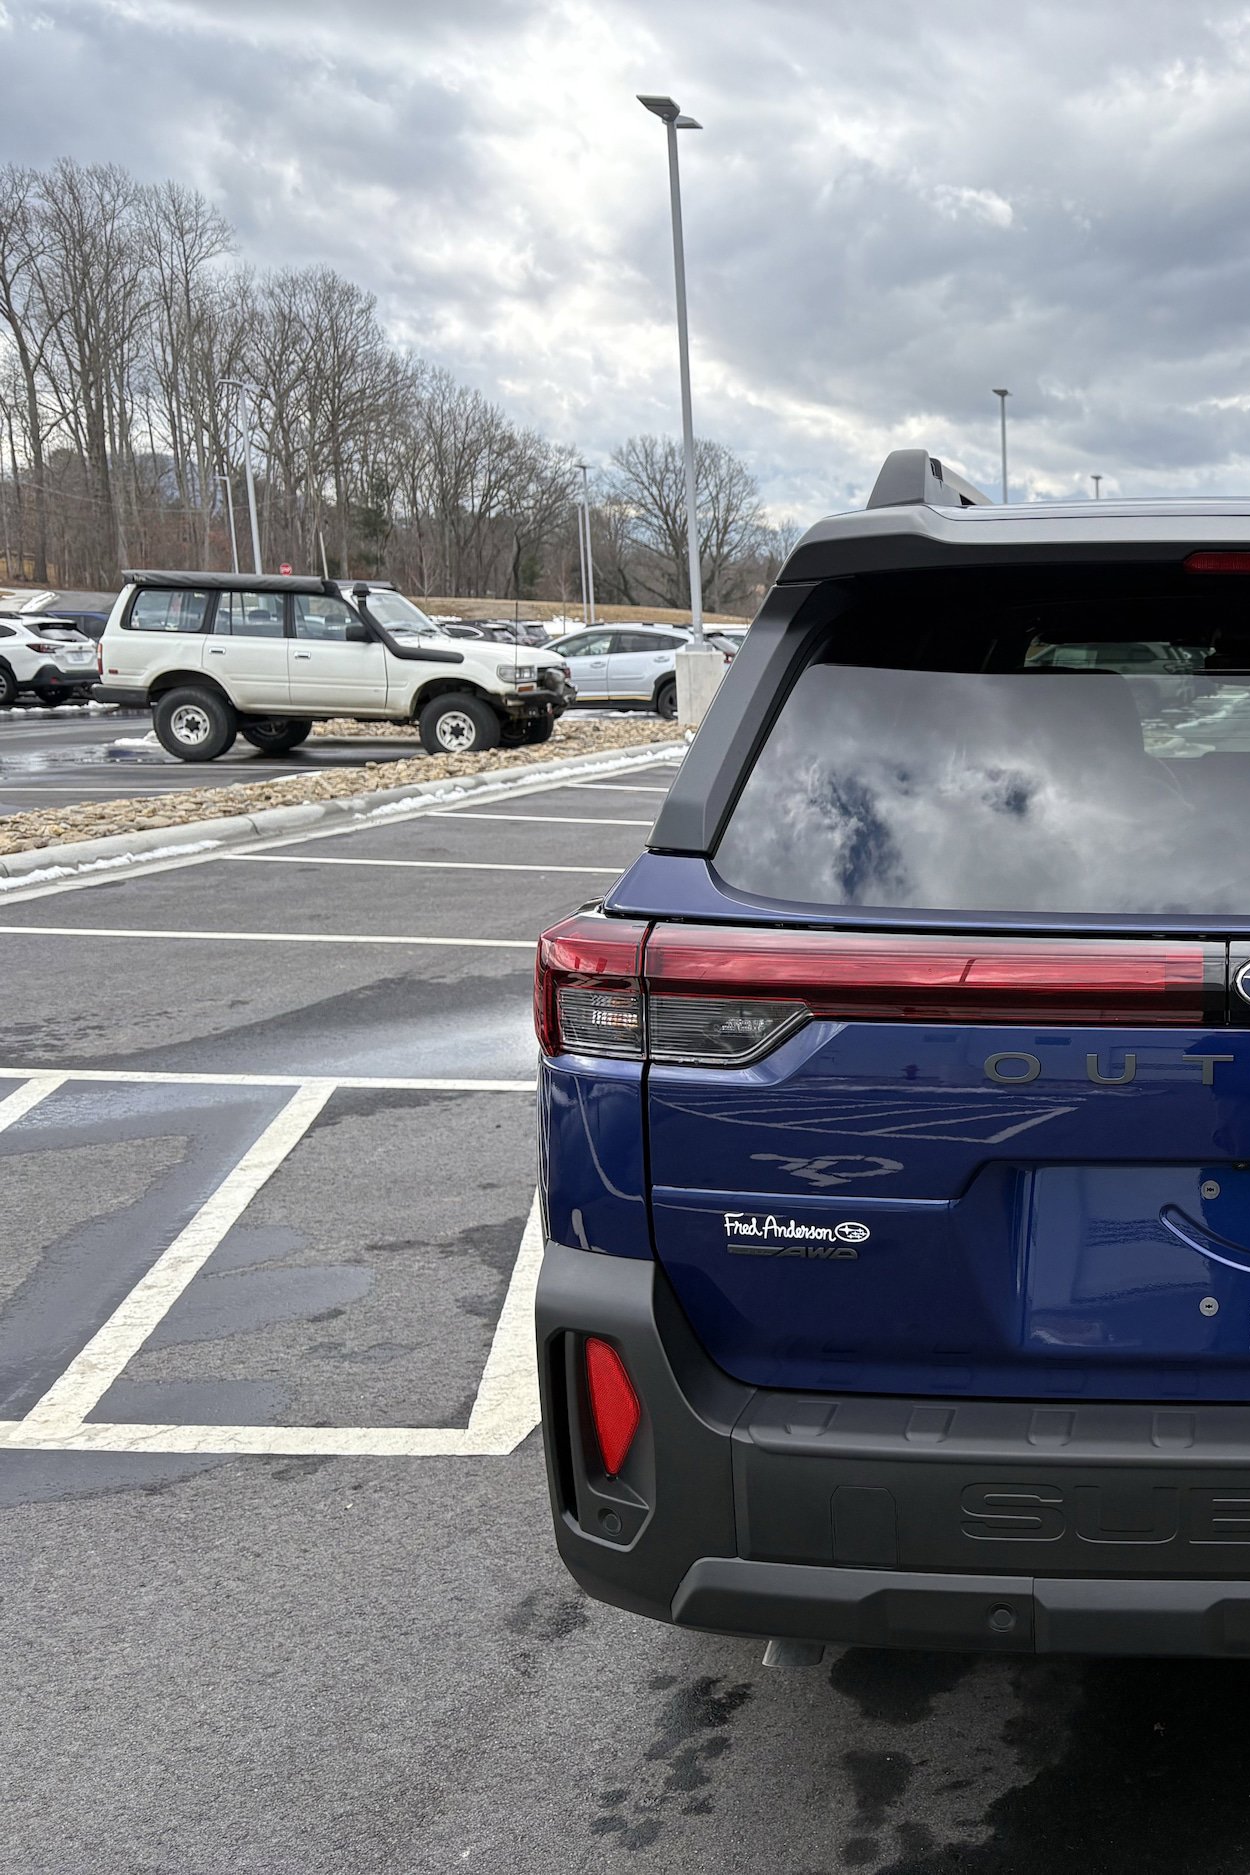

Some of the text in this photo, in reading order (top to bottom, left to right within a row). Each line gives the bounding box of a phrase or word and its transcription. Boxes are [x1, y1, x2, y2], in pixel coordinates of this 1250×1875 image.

[724, 1213, 836, 1242] Fred Anderson
[777, 1246, 858, 1260] AWD
